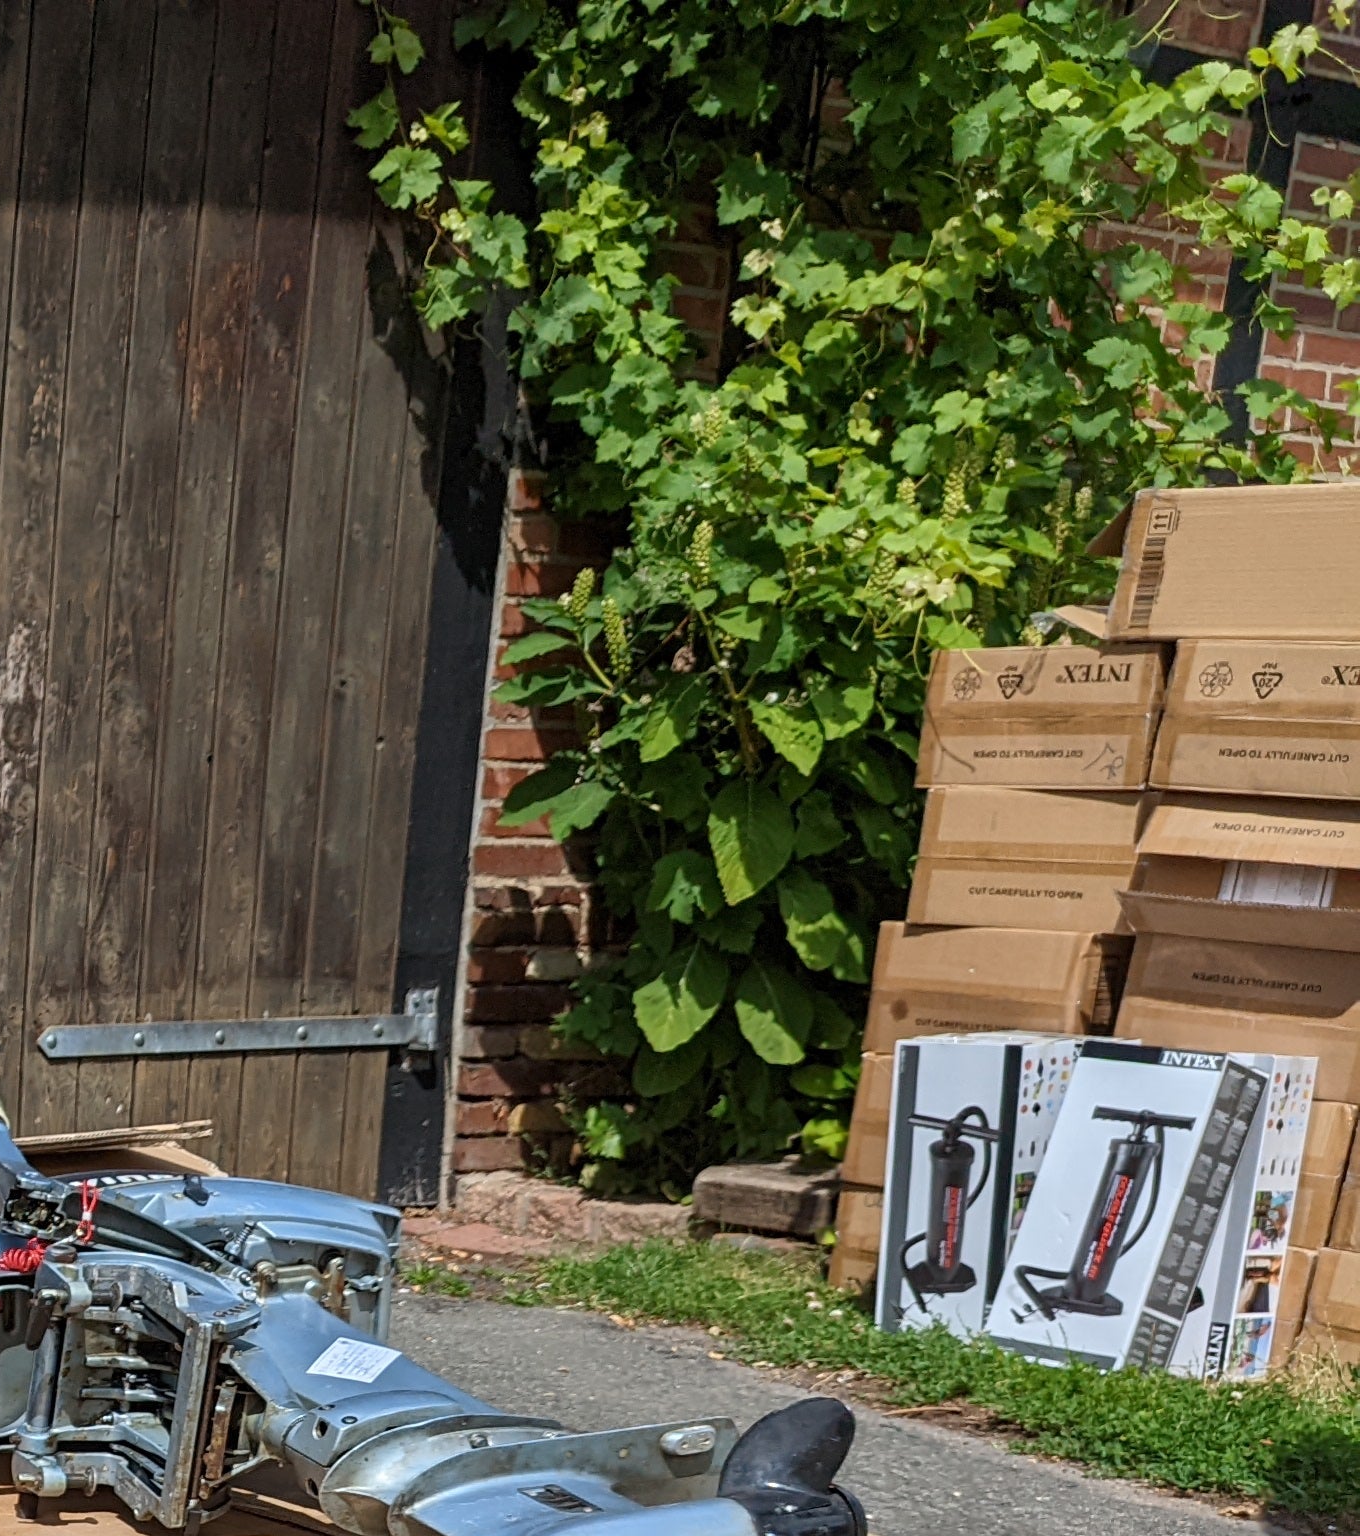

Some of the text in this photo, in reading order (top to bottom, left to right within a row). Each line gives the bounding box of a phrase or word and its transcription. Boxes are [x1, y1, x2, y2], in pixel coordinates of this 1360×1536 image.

[998, 750, 1010, 758] TO
[1011, 749, 1063, 759] CAREFULLY
[1218, 748, 1350, 763] CUT CAREFULLY TO OPEN
[1212, 822, 1345, 839] CUT CAREFULLY TO OPEN
[968, 886, 1083, 899] CUT CAREFULLY TO OPEN
[1236, 977, 1298, 992] CAREFULLY
[1300, 983, 1322, 993] CUT
[1160, 1050, 1224, 1069] INTEX
[1205, 1325, 1226, 1380] INTEX
